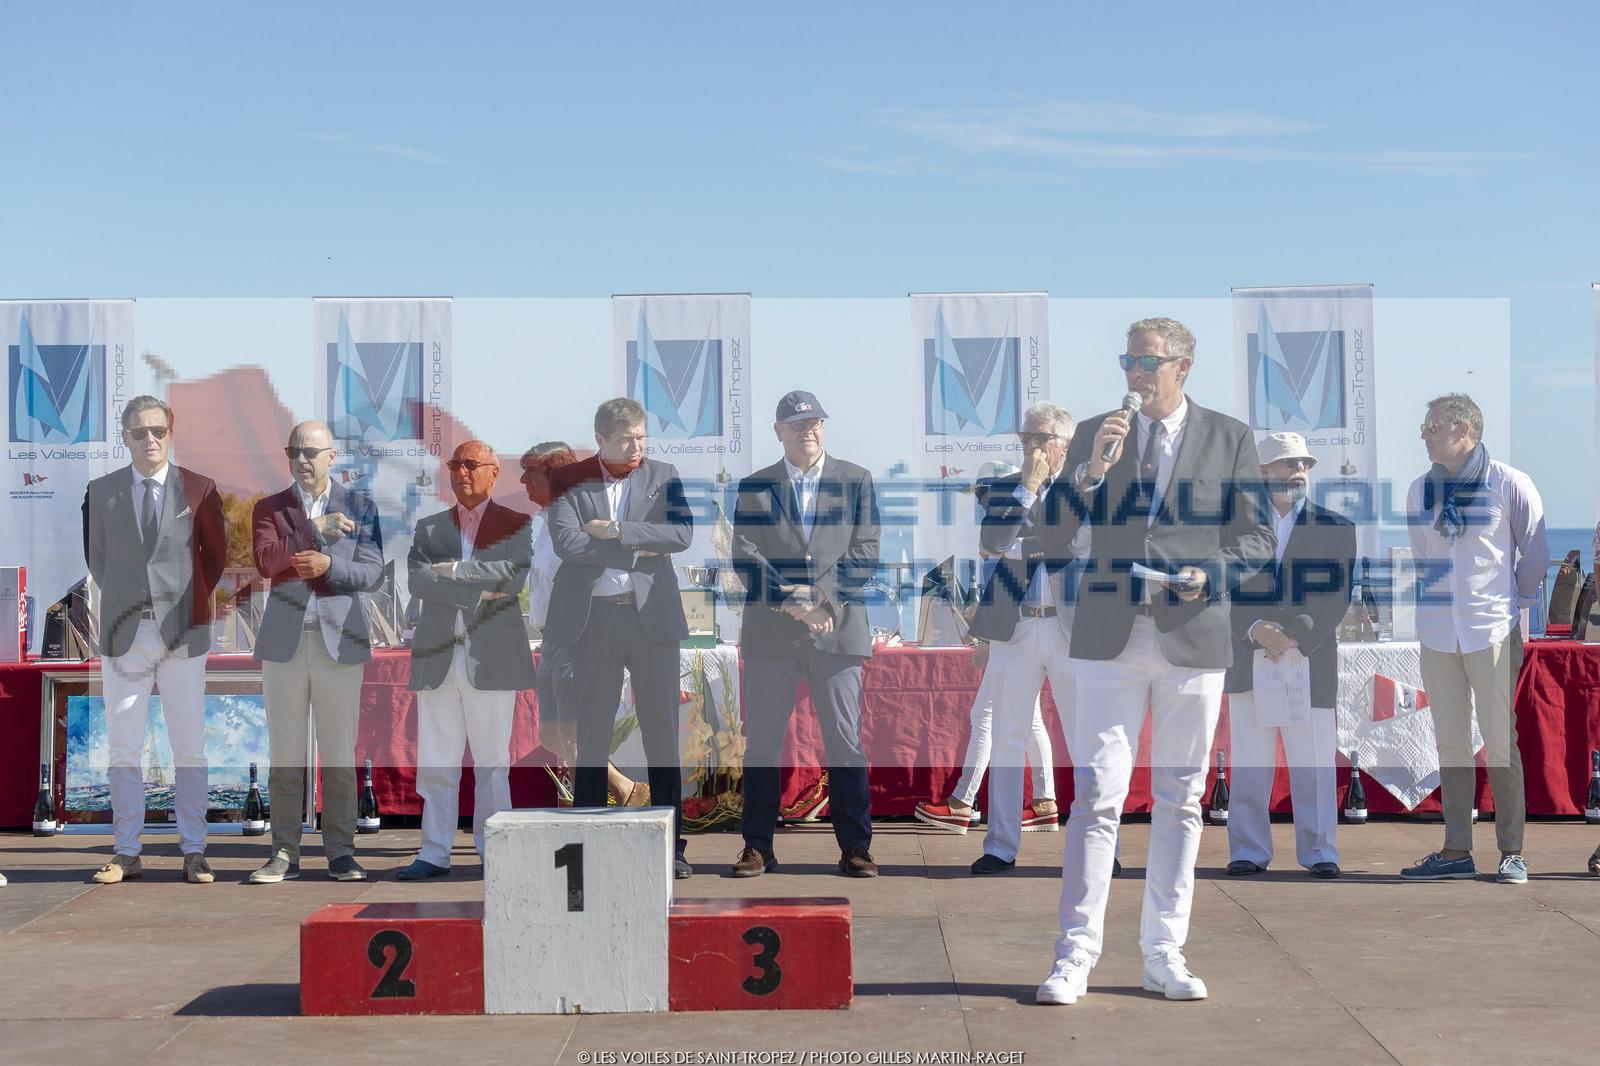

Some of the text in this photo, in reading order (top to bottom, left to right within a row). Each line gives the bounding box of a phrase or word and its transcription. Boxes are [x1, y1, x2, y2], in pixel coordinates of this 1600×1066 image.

[113, 343, 126, 459] Saint-Tropez
[429, 341, 443, 457] Saint-Tropez
[729, 338, 743, 454] Saint-Tropez
[1027, 336, 1041, 405] -Tropez
[1352, 329, 1366, 445] Saint-Tropez
[8, 449, 109, 460] Les Voiles de
[336, 446, 427, 457] es Voiles de
[658, 443, 704, 454] Voiles
[706, 443, 727, 454] de
[925, 441, 1023, 453] Les Voiles de
[1305, 436, 1350, 446] les de
[554, 843, 584, 912] 1
[367, 929, 416, 998] 2
[741, 925, 782, 995] 3
